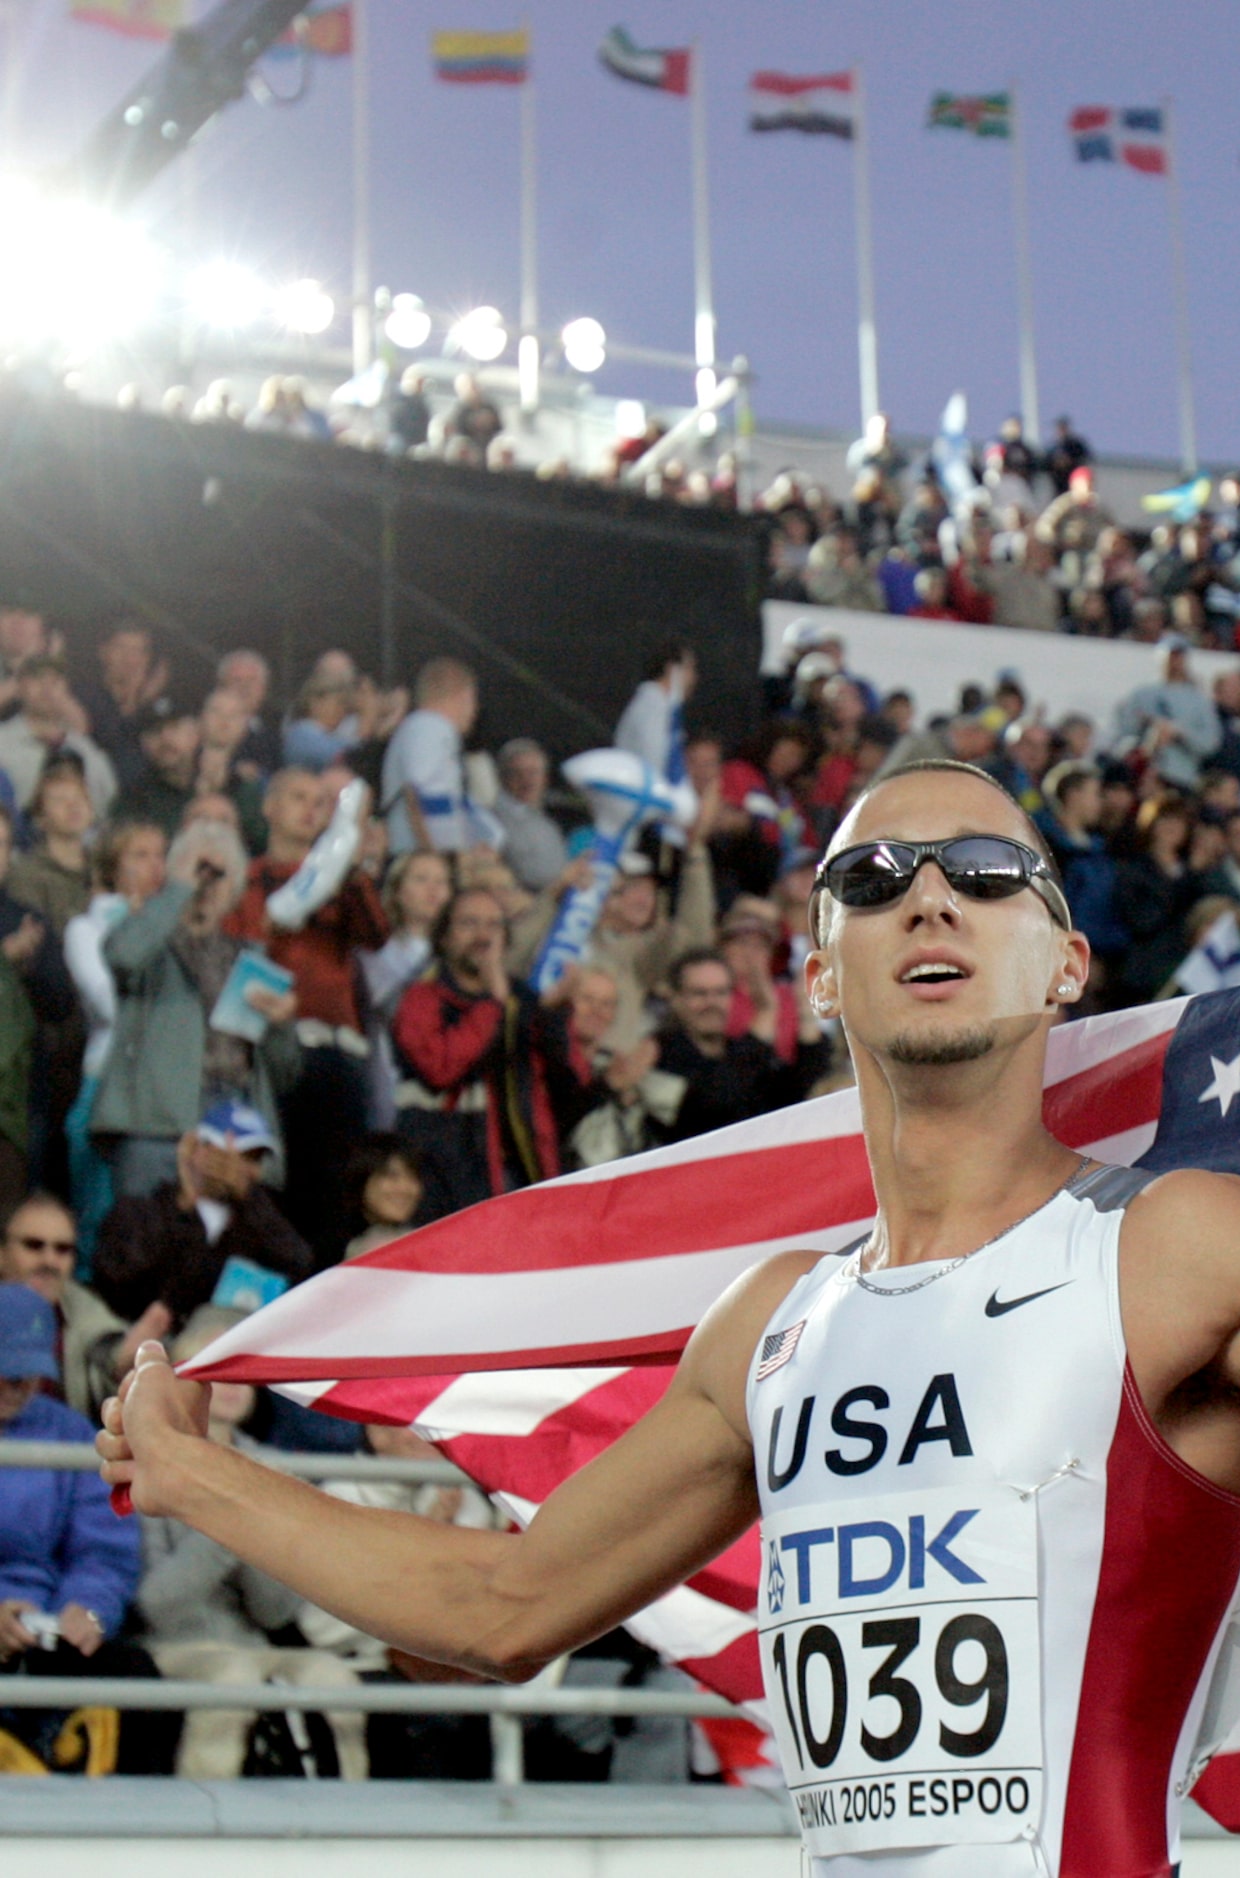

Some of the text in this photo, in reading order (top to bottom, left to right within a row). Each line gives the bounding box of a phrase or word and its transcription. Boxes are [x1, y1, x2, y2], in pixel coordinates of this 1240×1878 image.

[767, 1372, 975, 1493] USA
[780, 1508, 988, 1605] TDK
[772, 1612, 1010, 1771] 1039
[840, 1782, 896, 1824] 2005
[908, 1775, 1030, 1817] ESPOO
